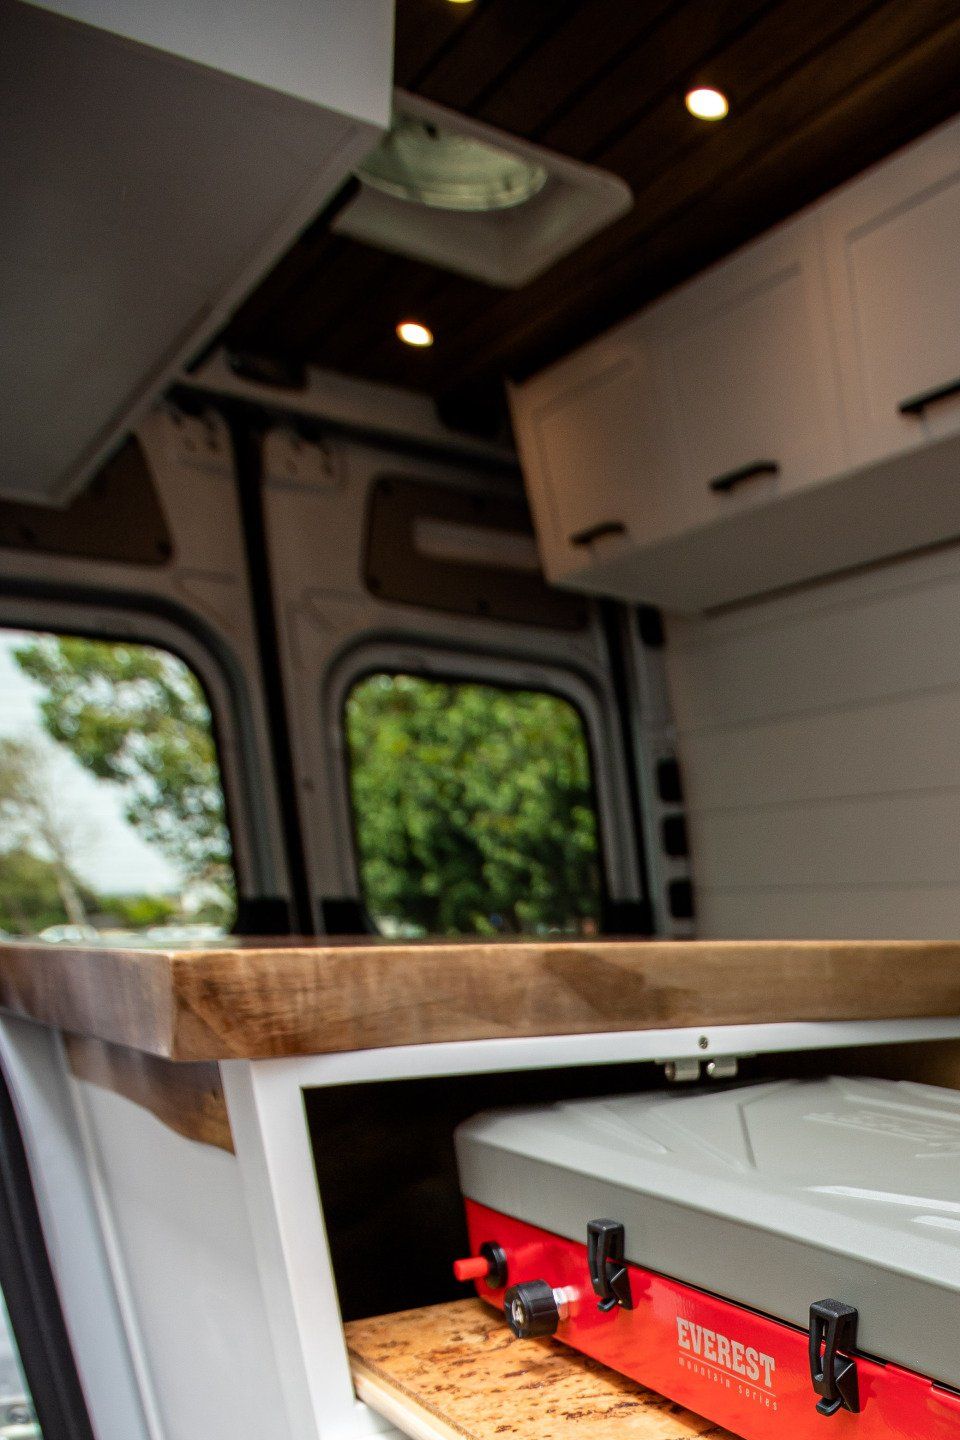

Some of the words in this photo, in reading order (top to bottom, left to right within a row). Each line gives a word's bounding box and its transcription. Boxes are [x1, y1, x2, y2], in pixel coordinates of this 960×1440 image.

[676, 1316, 776, 1388] EVEREST
[678, 1357, 730, 1389] mountain
[738, 1385, 778, 1411] series
